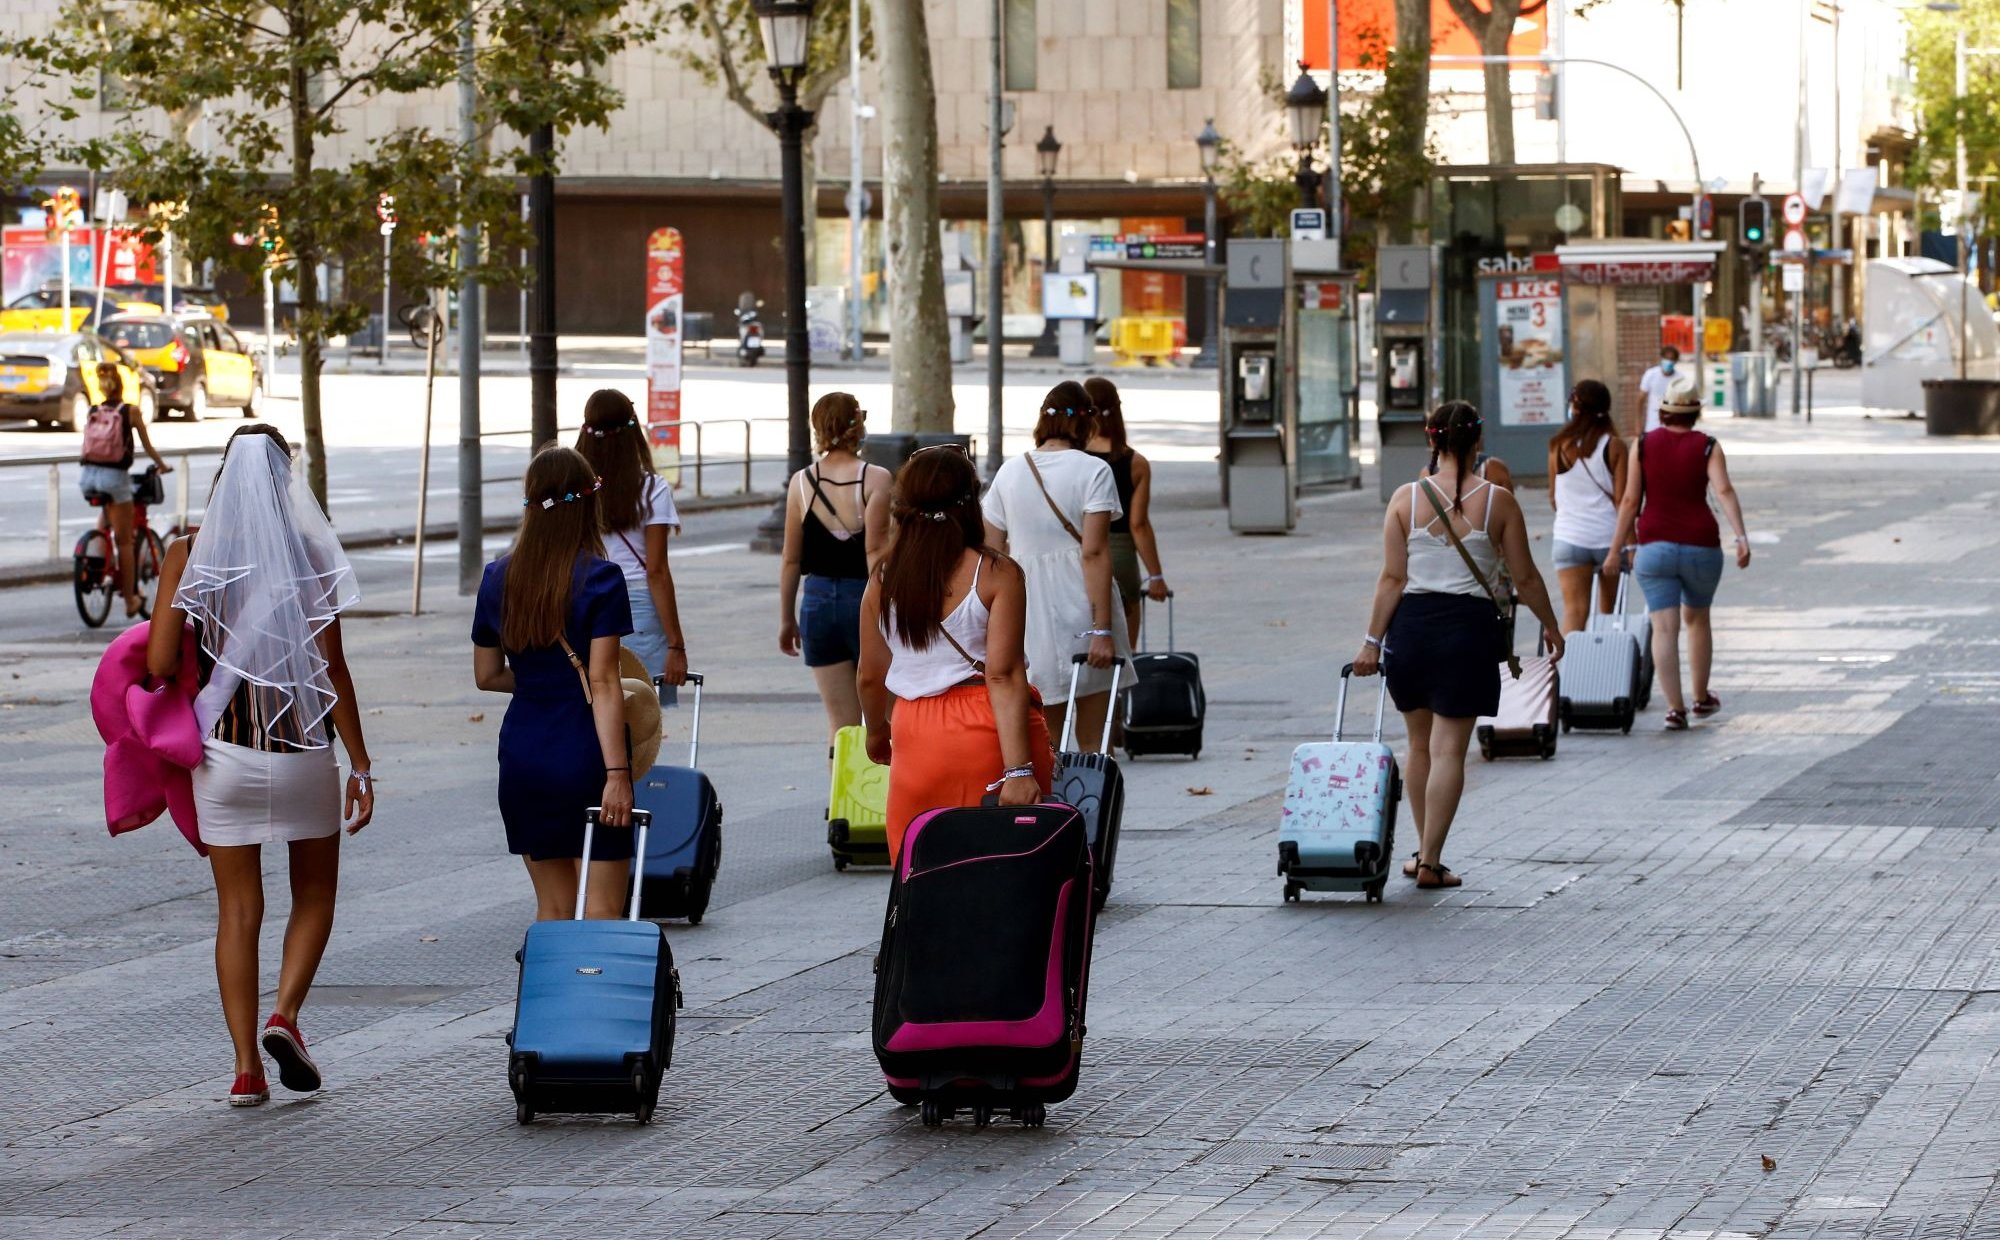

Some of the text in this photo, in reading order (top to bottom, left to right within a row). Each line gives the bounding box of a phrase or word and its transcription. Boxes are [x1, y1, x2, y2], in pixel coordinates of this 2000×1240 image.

[1583, 264, 1602, 284] el
[1515, 281, 1560, 297] KFC
[1532, 302, 1546, 328] 3
